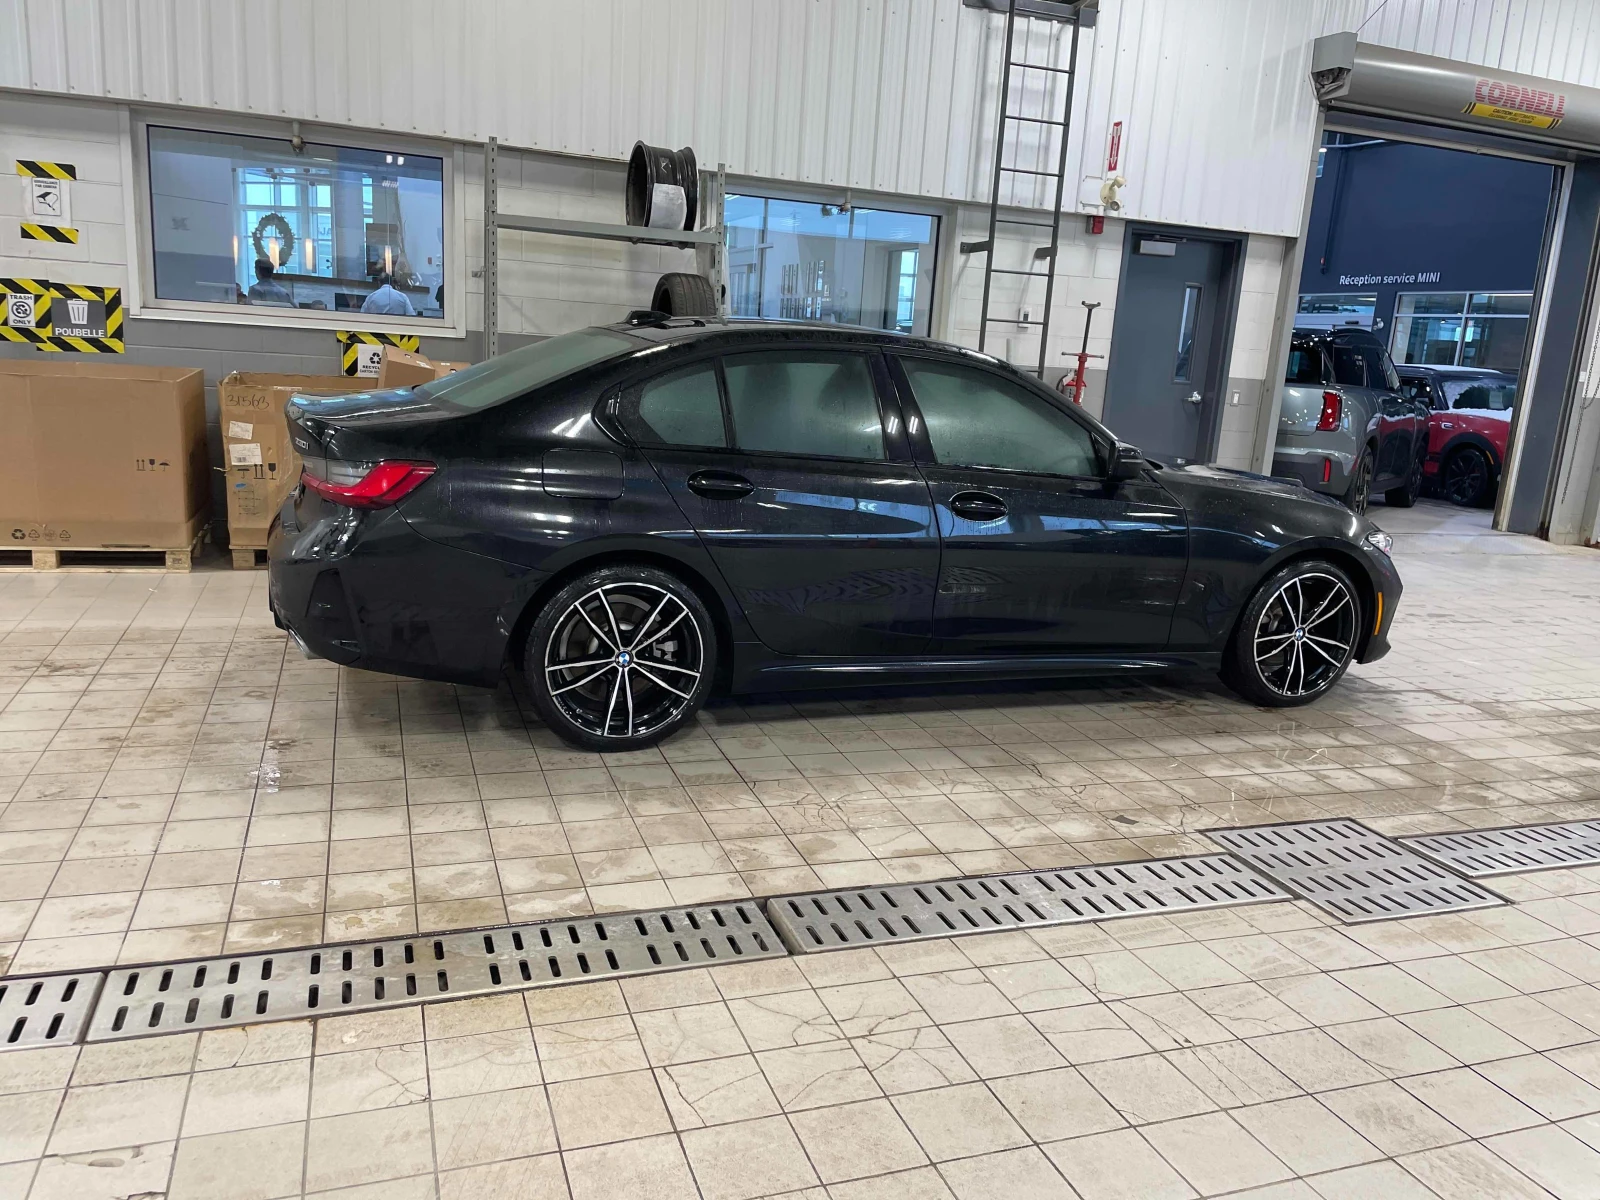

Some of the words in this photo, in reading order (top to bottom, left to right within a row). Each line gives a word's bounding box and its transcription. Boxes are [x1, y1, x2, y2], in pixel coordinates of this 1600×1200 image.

[1475, 79, 1565, 118] CORNELL
[1339, 274, 1381, 286] Réception
[1383, 273, 1415, 284] service
[1417, 272, 1440, 283] MINI
[54, 327, 105, 337] POUBELLE
[225, 394, 270, 410] 31563
